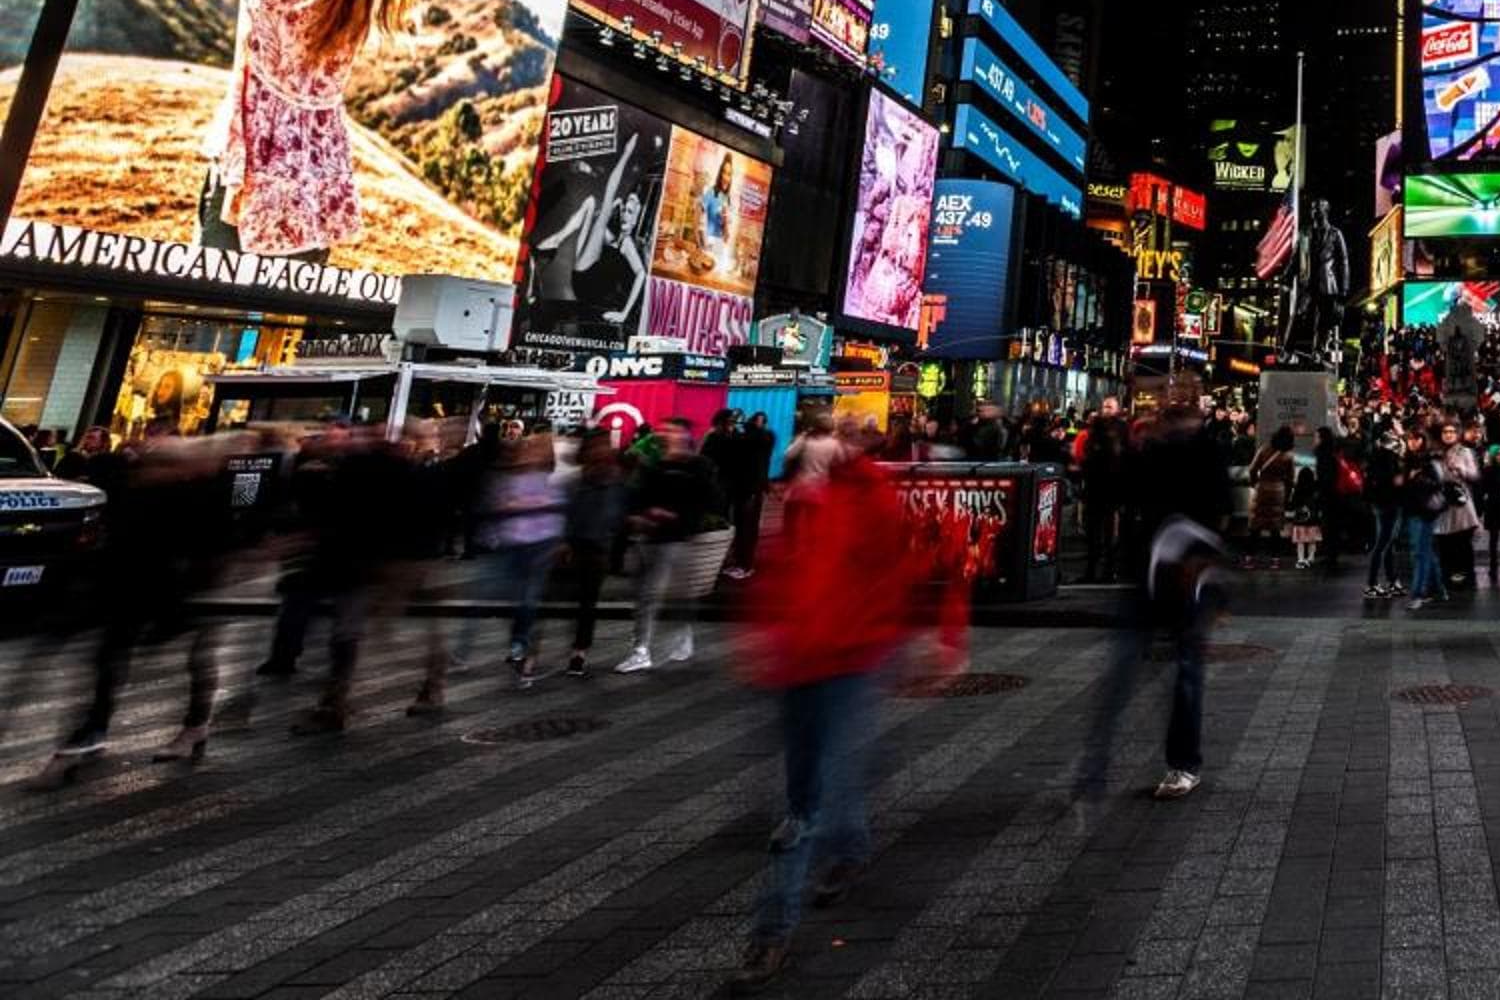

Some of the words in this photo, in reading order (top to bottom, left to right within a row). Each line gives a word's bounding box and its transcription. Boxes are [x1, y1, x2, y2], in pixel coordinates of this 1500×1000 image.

[550, 117, 571, 138] 20
[574, 111, 615, 134] YEARS
[935, 195, 973, 211] AEX
[935, 211, 992, 229] 437.49
[11, 221, 240, 282] AMERICAN
[254, 254, 350, 296] EAGLE
[610, 357, 663, 377] NYC
[954, 488, 1007, 525] BOYS
